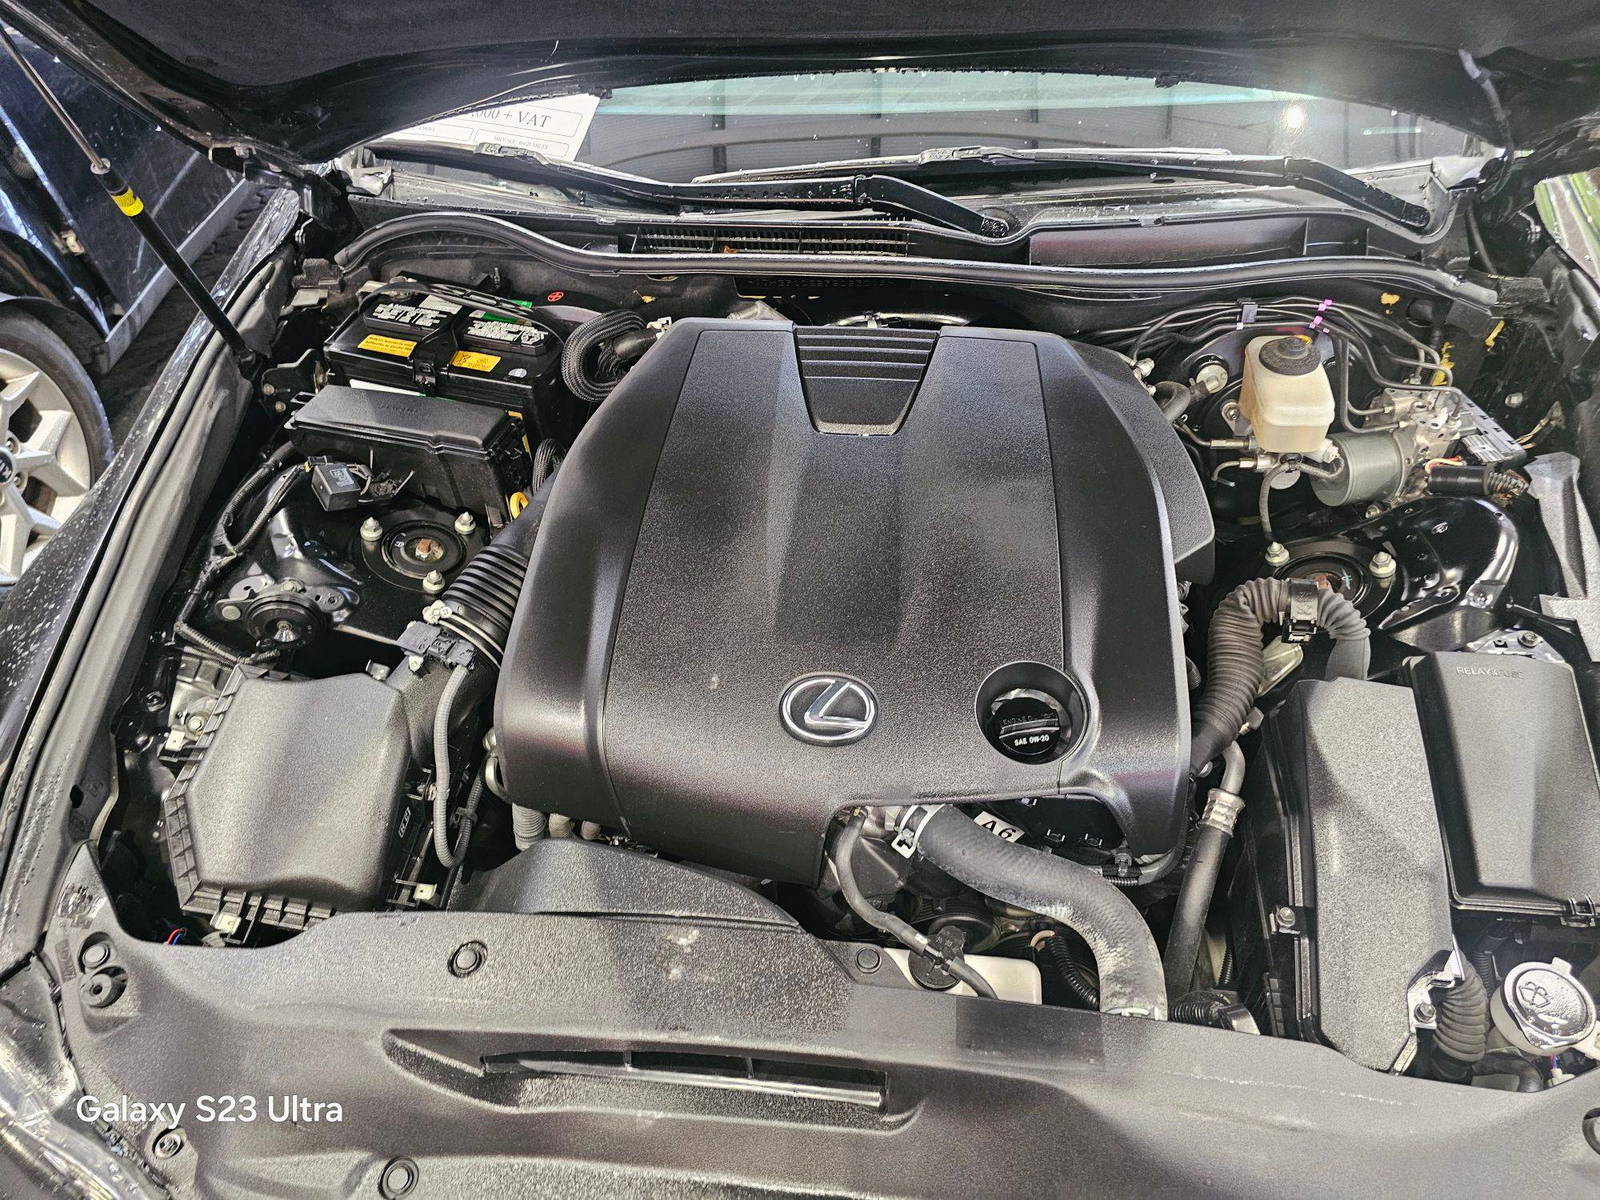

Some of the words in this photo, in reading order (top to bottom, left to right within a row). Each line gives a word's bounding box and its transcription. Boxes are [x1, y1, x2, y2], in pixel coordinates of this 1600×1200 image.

[518, 111, 552, 128] VAT
[1014, 738, 1028, 747] SAE
[982, 820, 1017, 840] A6
